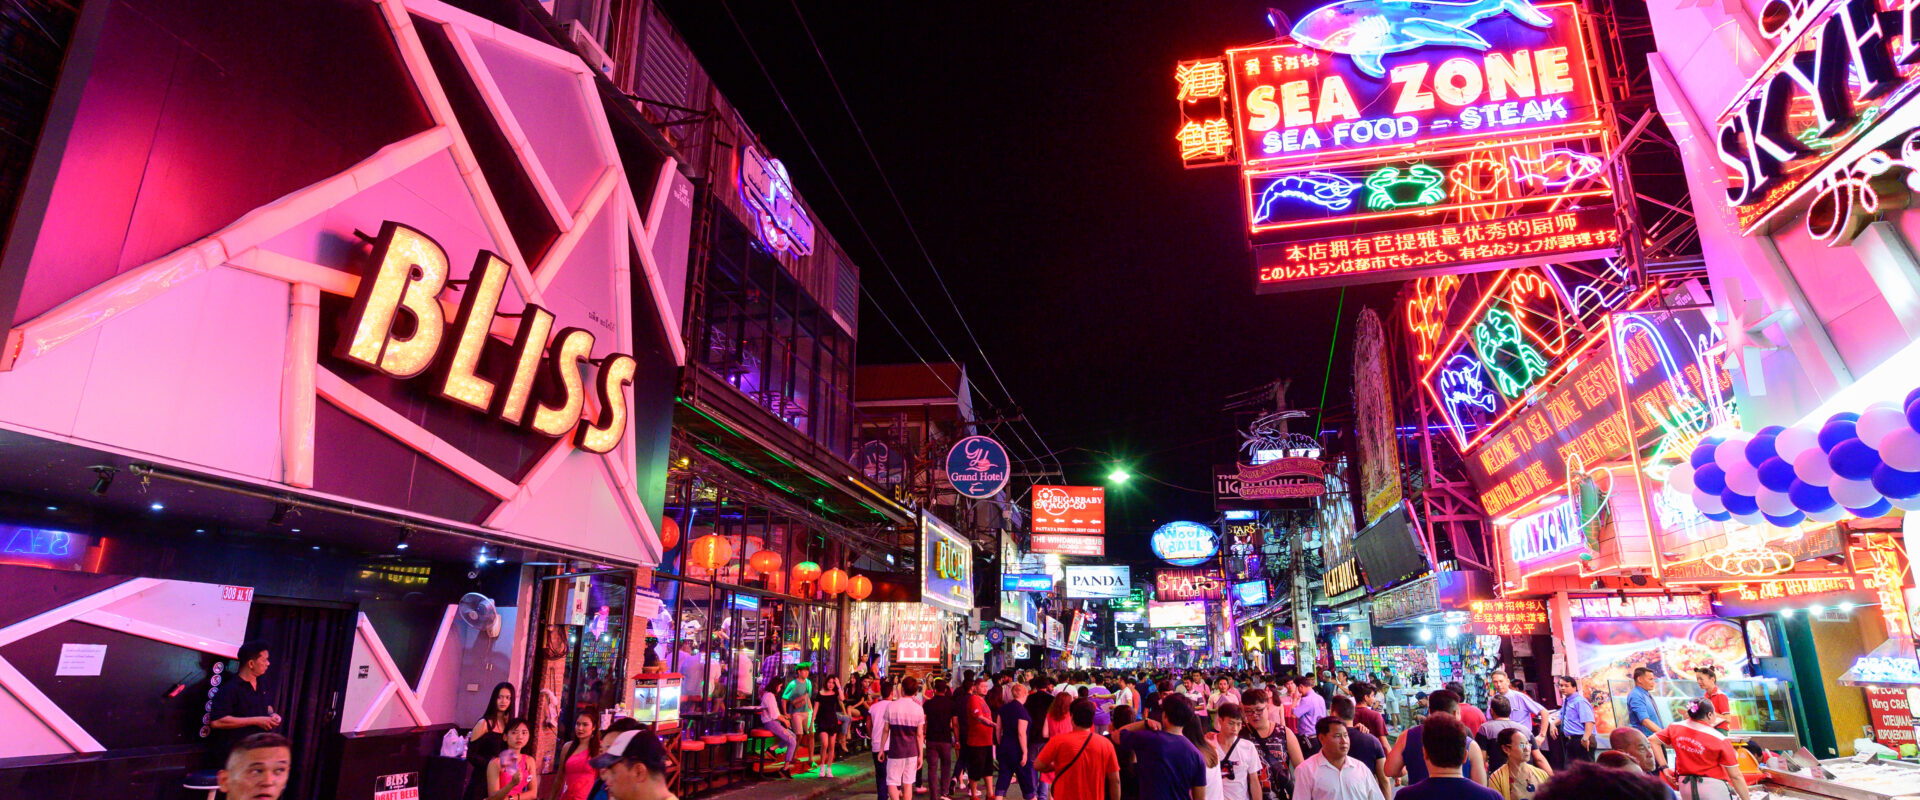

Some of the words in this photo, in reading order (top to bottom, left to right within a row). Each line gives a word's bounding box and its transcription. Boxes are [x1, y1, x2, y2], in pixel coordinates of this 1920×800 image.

[1247, 75, 1361, 131] SEA
[1391, 46, 1574, 115] ZONE
[1263, 127, 1321, 153] SEA
[1333, 116, 1418, 145] FOOD
[1459, 97, 1567, 130] STEAK
[1286, 212, 1577, 262] 本店拥有芭提雅最优秀的厨师
[345, 220, 637, 454] BLISS
[1478, 435, 1520, 476] WELCOME
[1511, 424, 1532, 452] TO
[1526, 411, 1554, 444] SEA
[1547, 390, 1582, 432] ZONE
[951, 472, 978, 482] Grand
[980, 471, 1004, 481] Hotel
[1050, 502, 1082, 510] AGO-GO
[1053, 496, 1103, 504] SUGARBABY
[1228, 524, 1255, 534] STARS
[1048, 536, 1082, 544] WINDMILL
[1085, 537, 1103, 546] CLUB
[1168, 540, 1203, 554] BALL
[1072, 575, 1125, 586] PANDA
[1157, 573, 1219, 592] STARS
[223, 586, 237, 599] 308
[1177, 588, 1200, 598] CLUB
[1487, 623, 1535, 634] 价格公平
[1872, 698, 1890, 711] King
[385, 773, 409, 787] BLISS
[400, 788, 418, 800] BEER
